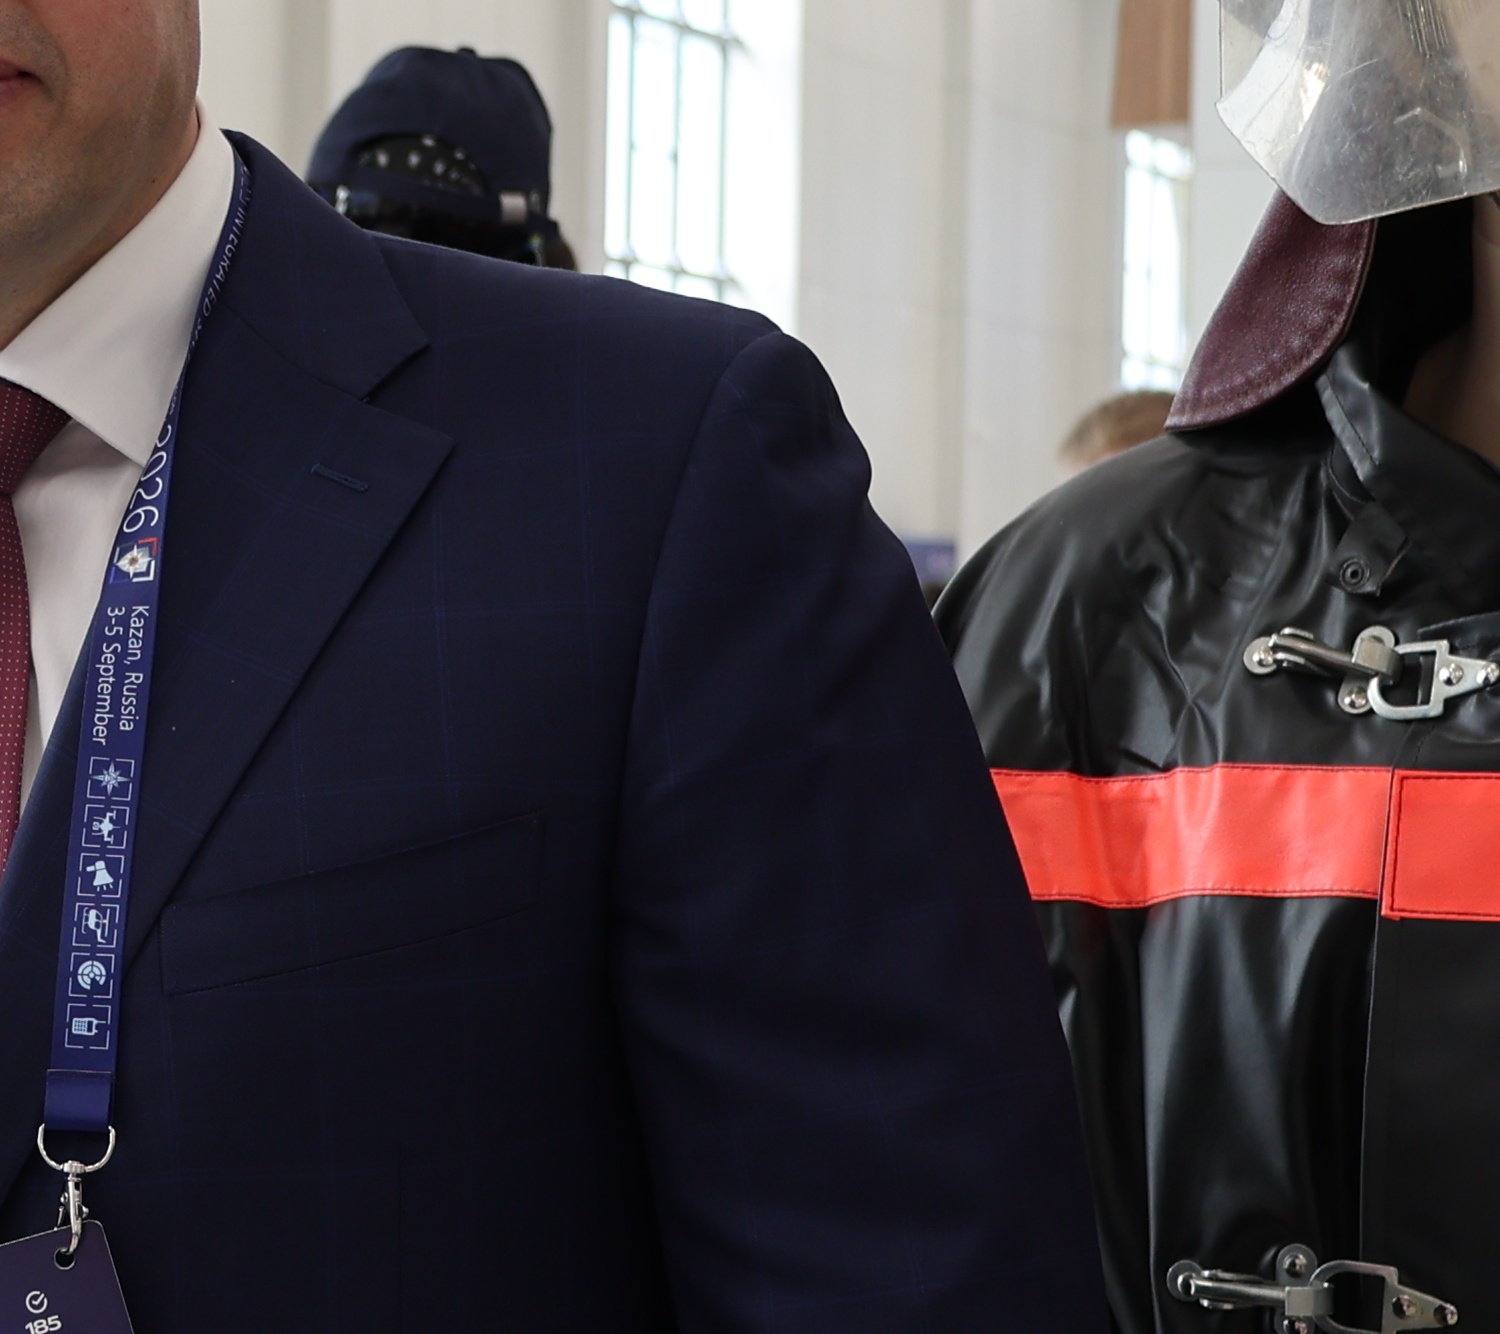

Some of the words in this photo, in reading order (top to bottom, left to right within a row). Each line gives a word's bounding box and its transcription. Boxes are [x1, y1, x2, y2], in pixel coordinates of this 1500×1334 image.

[122, 423, 174, 535] 2026
[104, 605, 126, 637] 3-5
[127, 605, 150, 669] Kazan,
[92, 640, 122, 746] September
[118, 672, 145, 733] Russia
